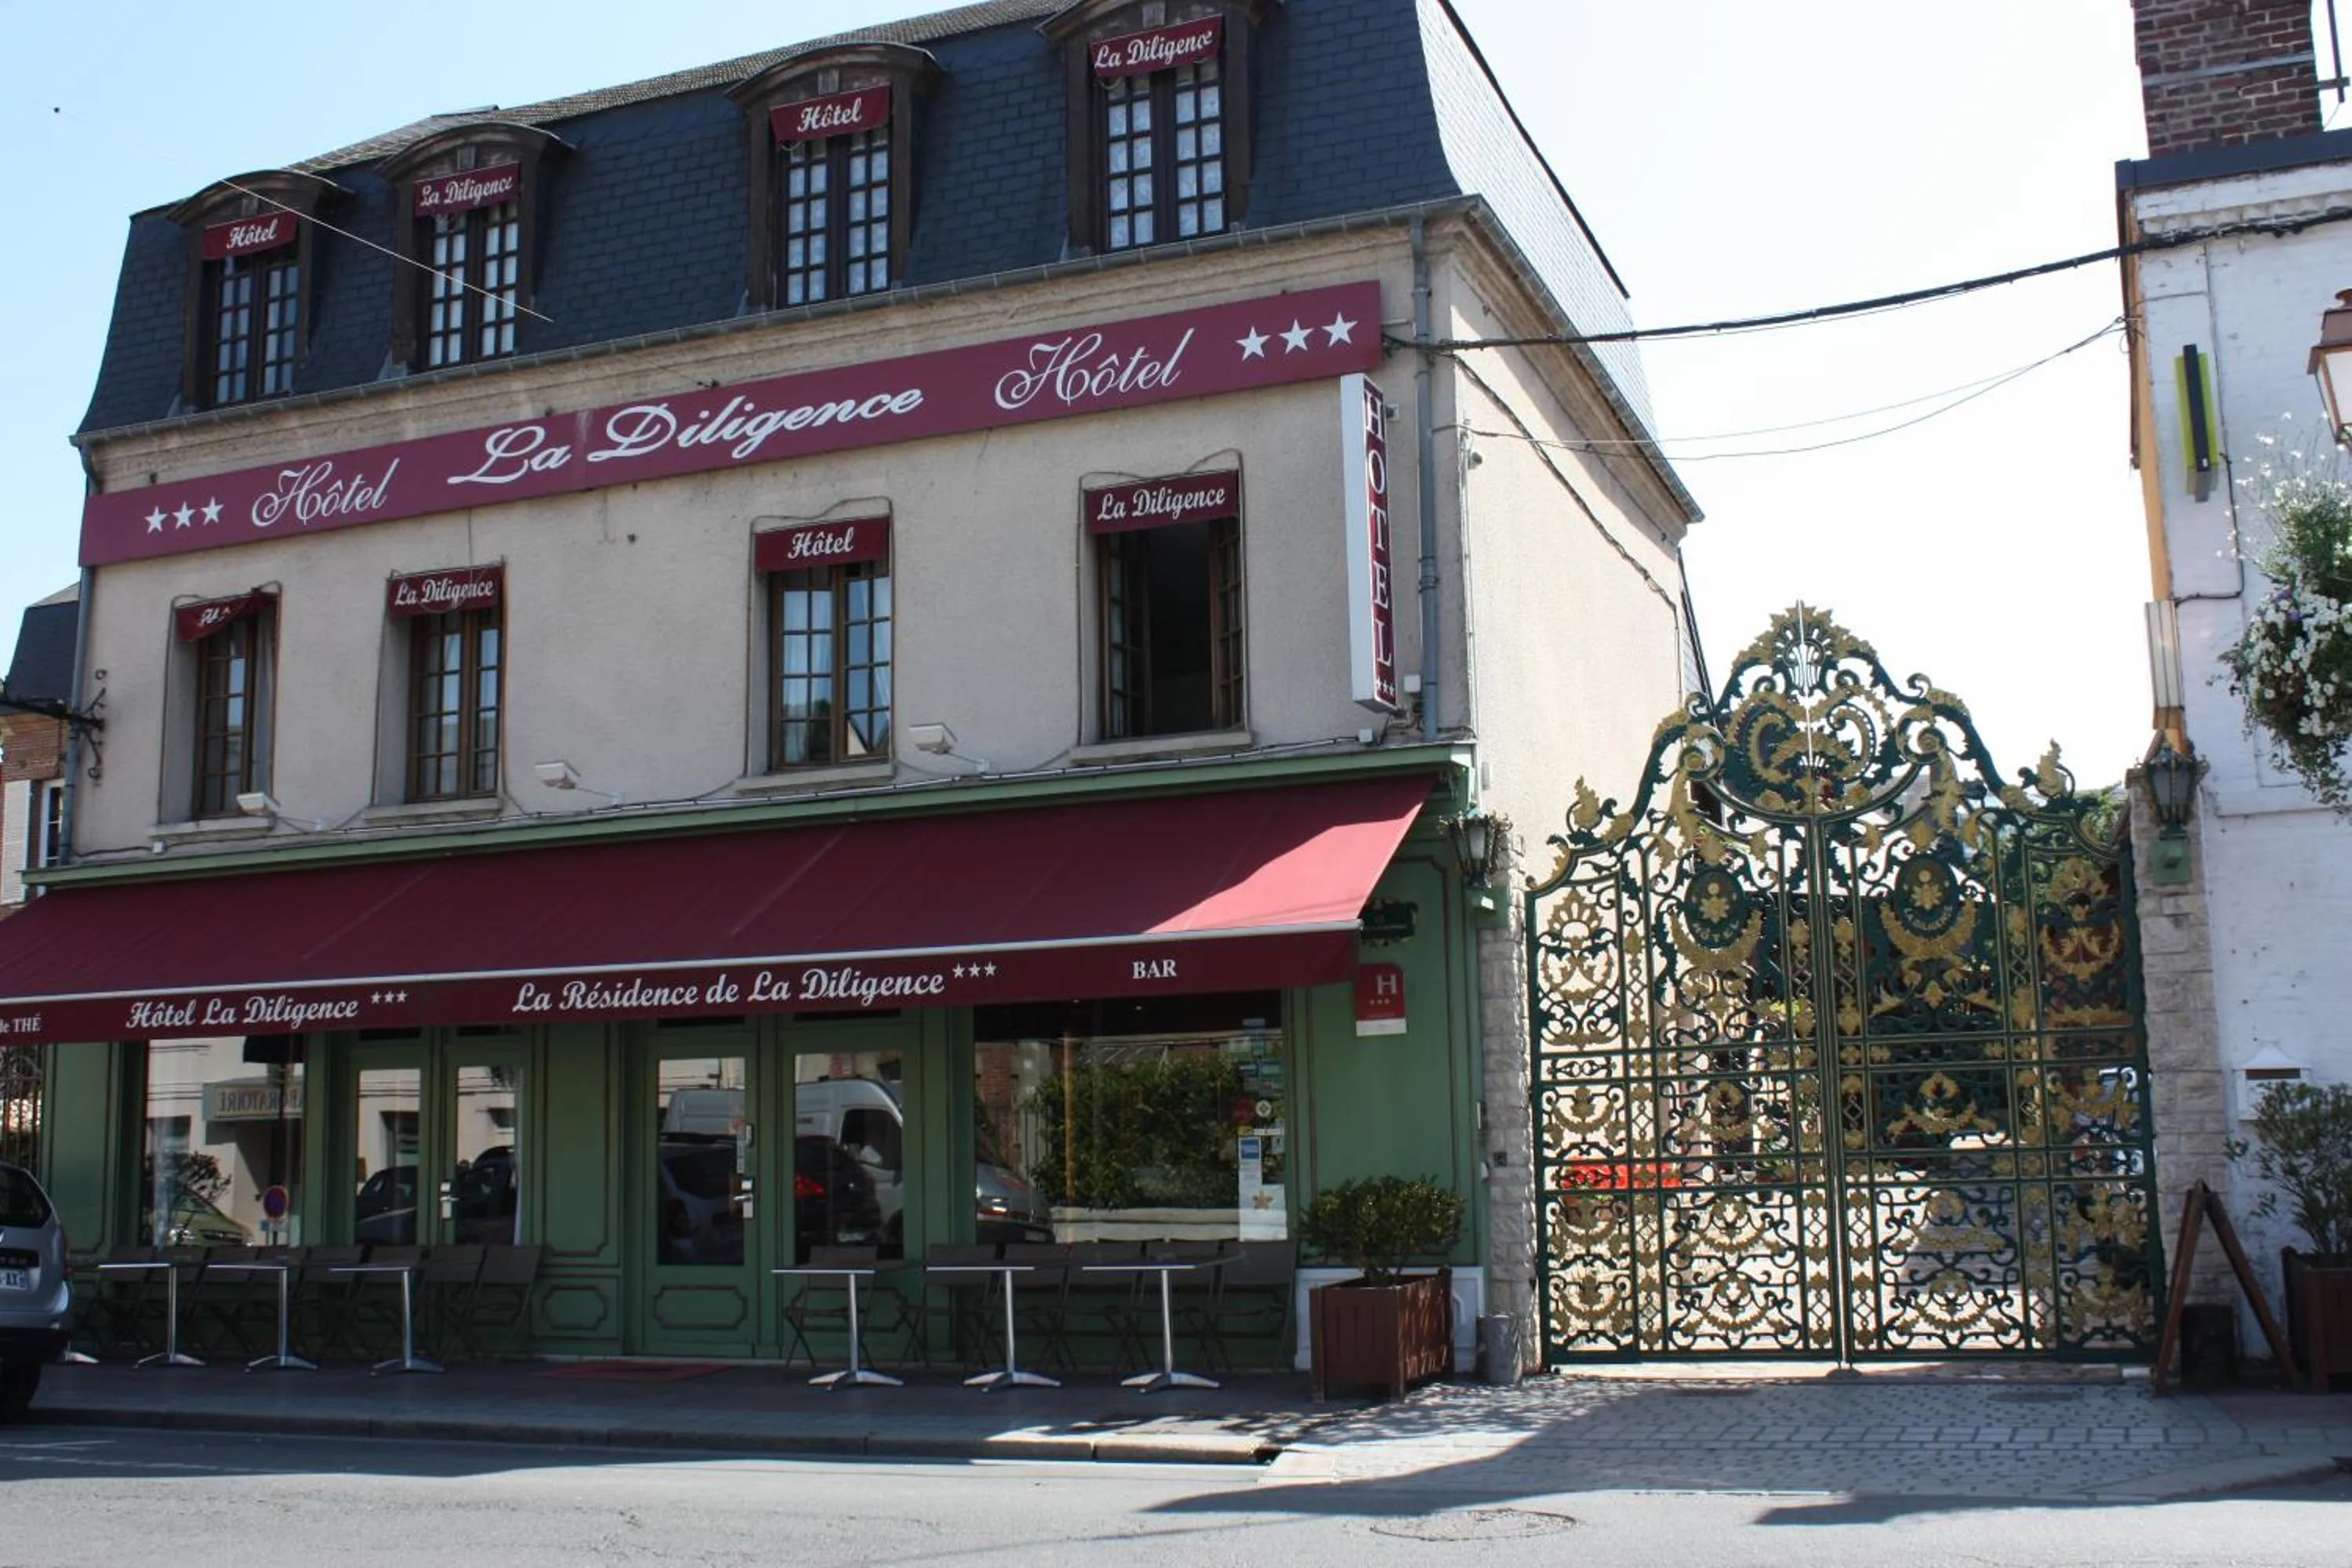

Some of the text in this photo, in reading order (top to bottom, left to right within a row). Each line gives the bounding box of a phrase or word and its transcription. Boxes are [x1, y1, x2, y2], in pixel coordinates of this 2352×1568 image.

[1094, 30, 1213, 69] La Diligence
[797, 97, 862, 132] Hôtel
[420, 176, 513, 207] La Diligence
[226, 218, 278, 249] Hôtel
[251, 328, 1196, 528] Hôtel La Diligence Hôtel
[1097, 486, 1225, 521] La Diligence
[787, 526, 854, 559] Hôtel
[1363, 389, 1392, 669] HOTEL
[394, 577, 494, 608] La Diligence
[1133, 959, 1177, 979] BAR
[1377, 975, 1398, 995] H
[512, 967, 945, 1012] La Résidence de La Diligence
[13, 1013, 42, 1033] THÉ
[125, 995, 358, 1029] Hôtel La Diligence
